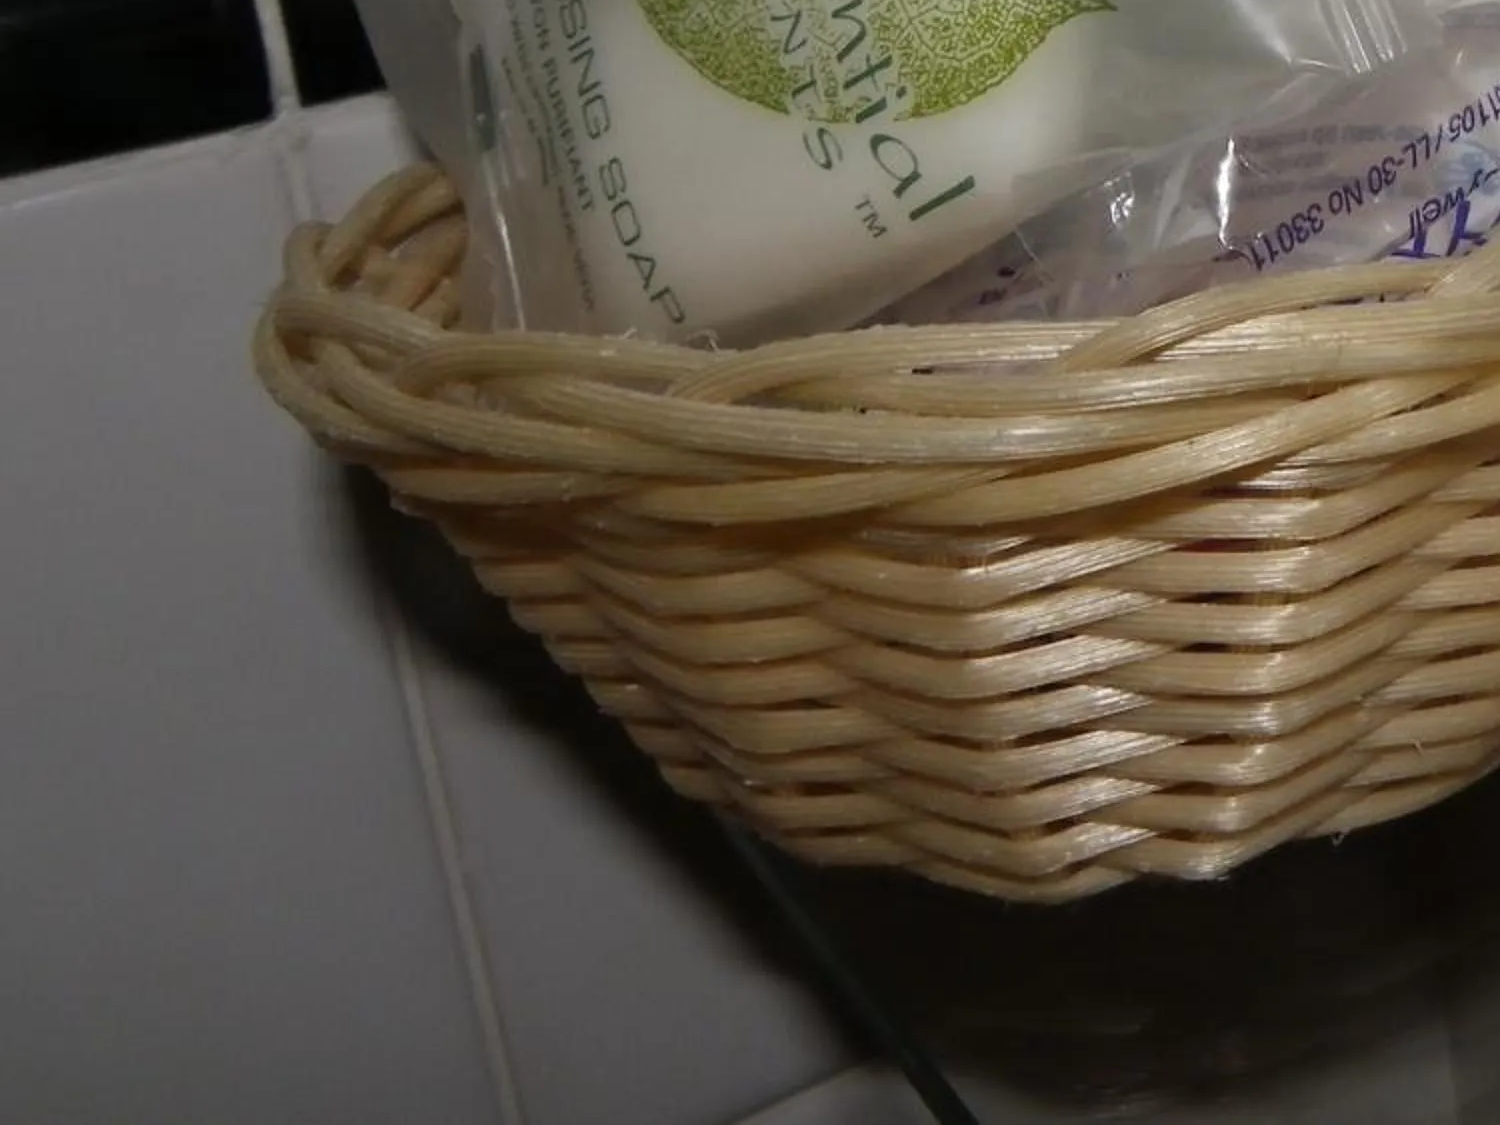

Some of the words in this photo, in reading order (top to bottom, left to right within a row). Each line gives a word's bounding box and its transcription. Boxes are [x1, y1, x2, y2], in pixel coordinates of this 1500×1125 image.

[1367, 133, 1432, 197] LL-30
[1327, 184, 1364, 217] No
[600, 157, 685, 323] SOAP
